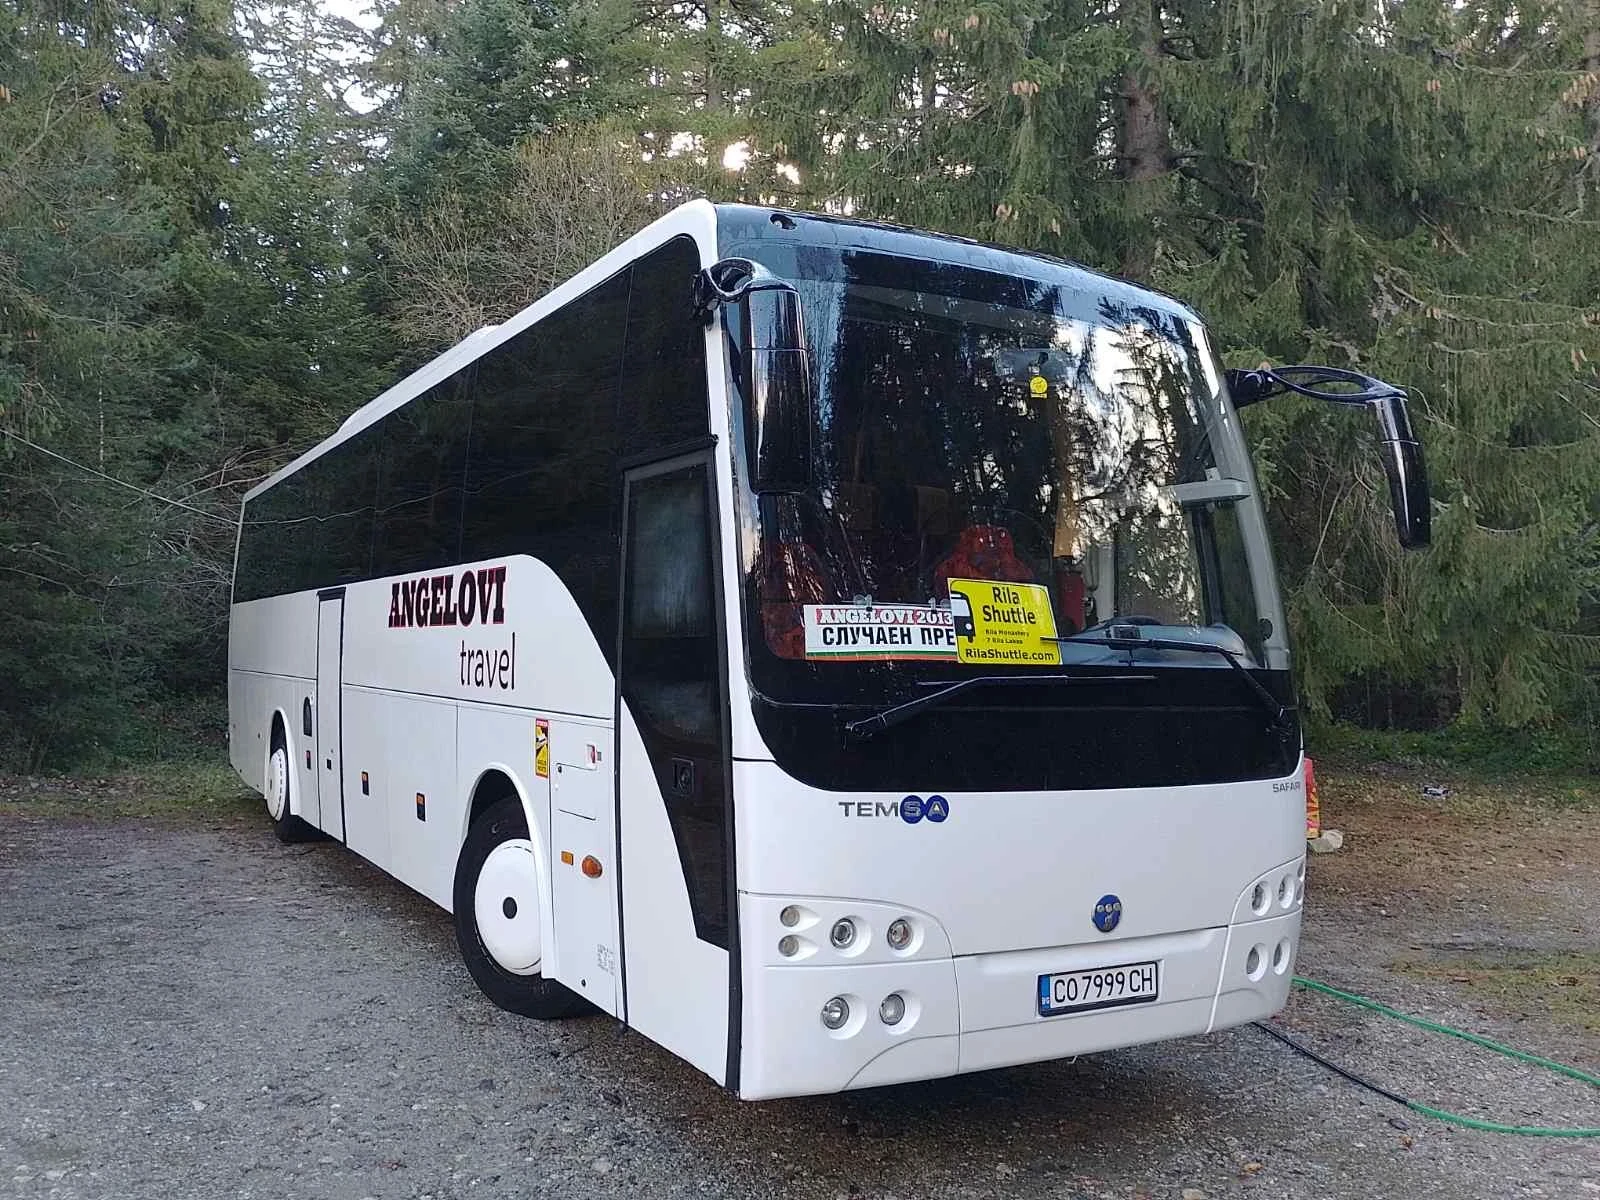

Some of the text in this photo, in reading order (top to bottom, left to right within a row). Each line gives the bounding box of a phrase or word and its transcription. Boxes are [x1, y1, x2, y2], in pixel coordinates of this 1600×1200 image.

[388, 566, 507, 628] ANGELOVI
[992, 586, 1020, 604] Rila
[819, 608, 953, 625] ANGELOVI 2013
[982, 605, 1036, 624] Shuttle
[822, 626, 955, 646] СЛУЧАЕН ПРЕ
[459, 631, 516, 690] travel
[966, 648, 1054, 661] RilaShuttle.com
[838, 797, 948, 821] TEMSA
[1082, 971, 1125, 1000] 7999
